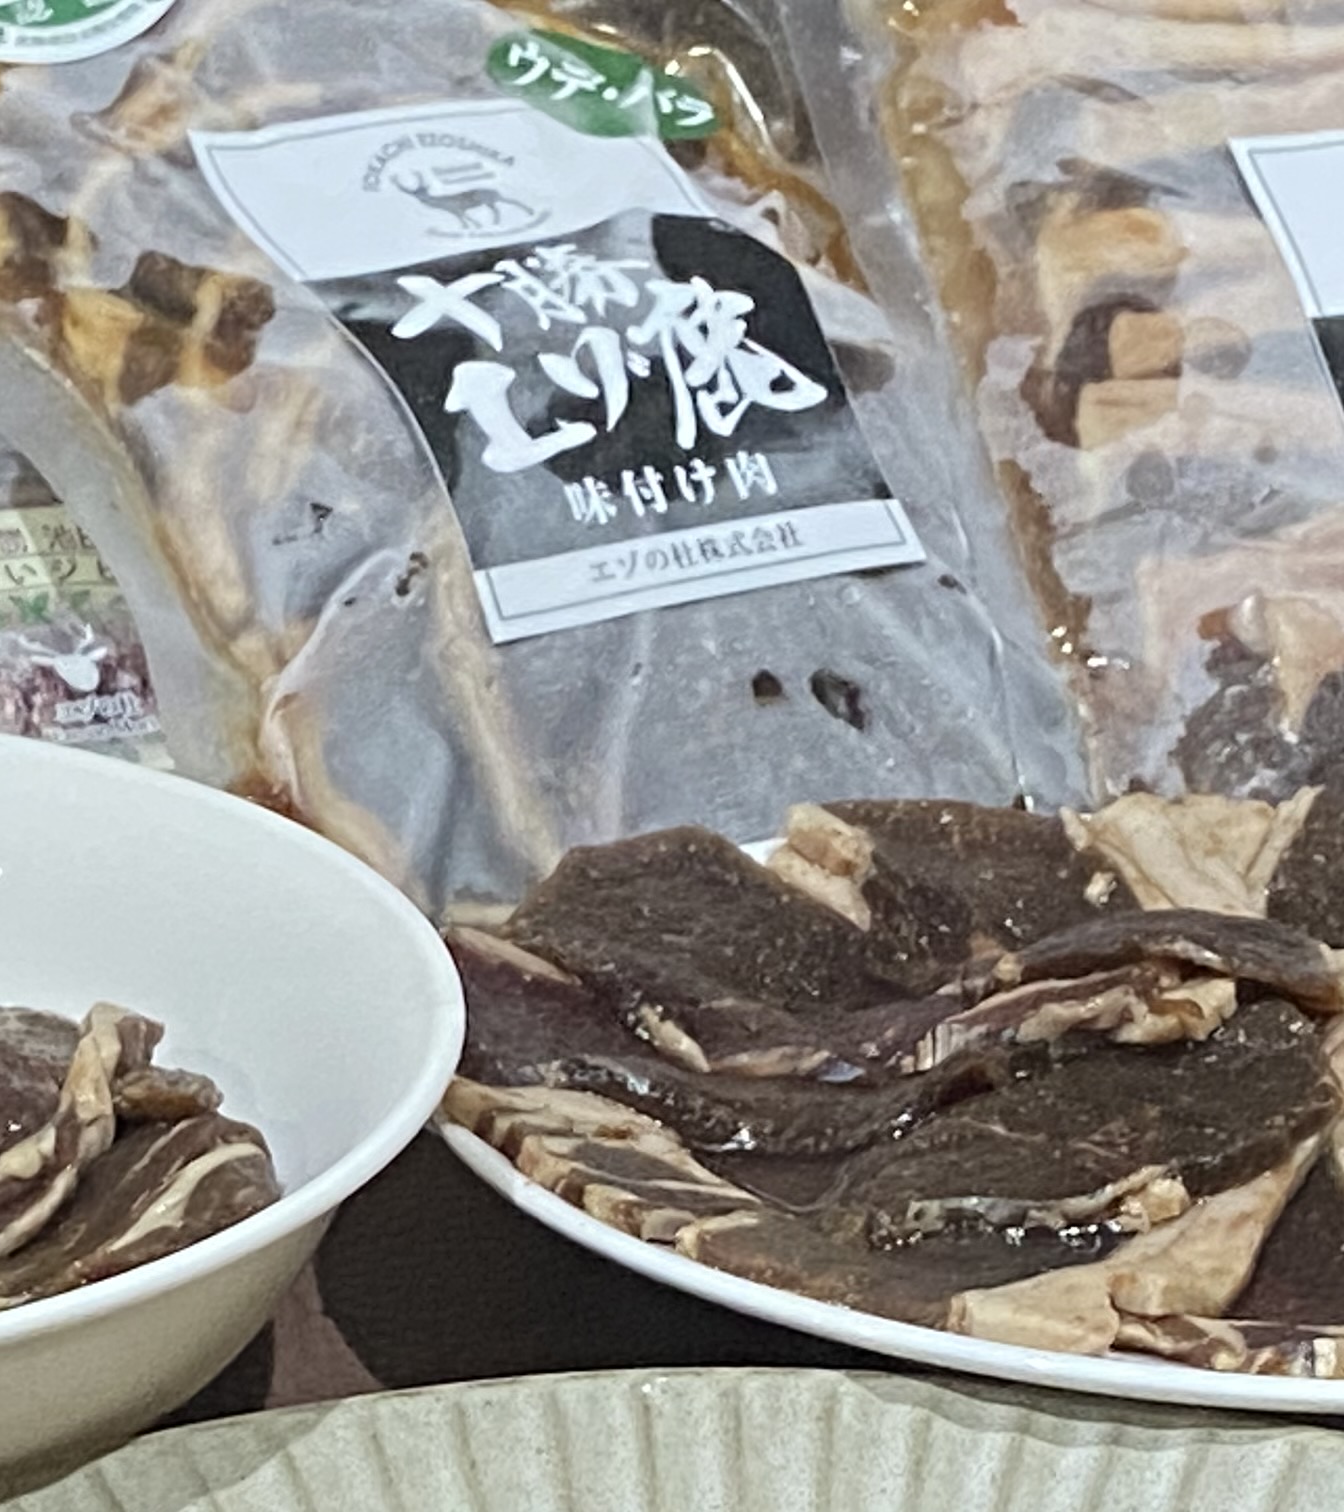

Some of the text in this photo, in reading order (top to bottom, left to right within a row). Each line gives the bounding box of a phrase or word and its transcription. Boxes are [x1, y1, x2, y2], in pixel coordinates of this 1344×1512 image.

[508, 41, 715, 127] ウデ・バラ
[391, 243, 651, 352] 十勝
[564, 450, 778, 525] 味付け肉
